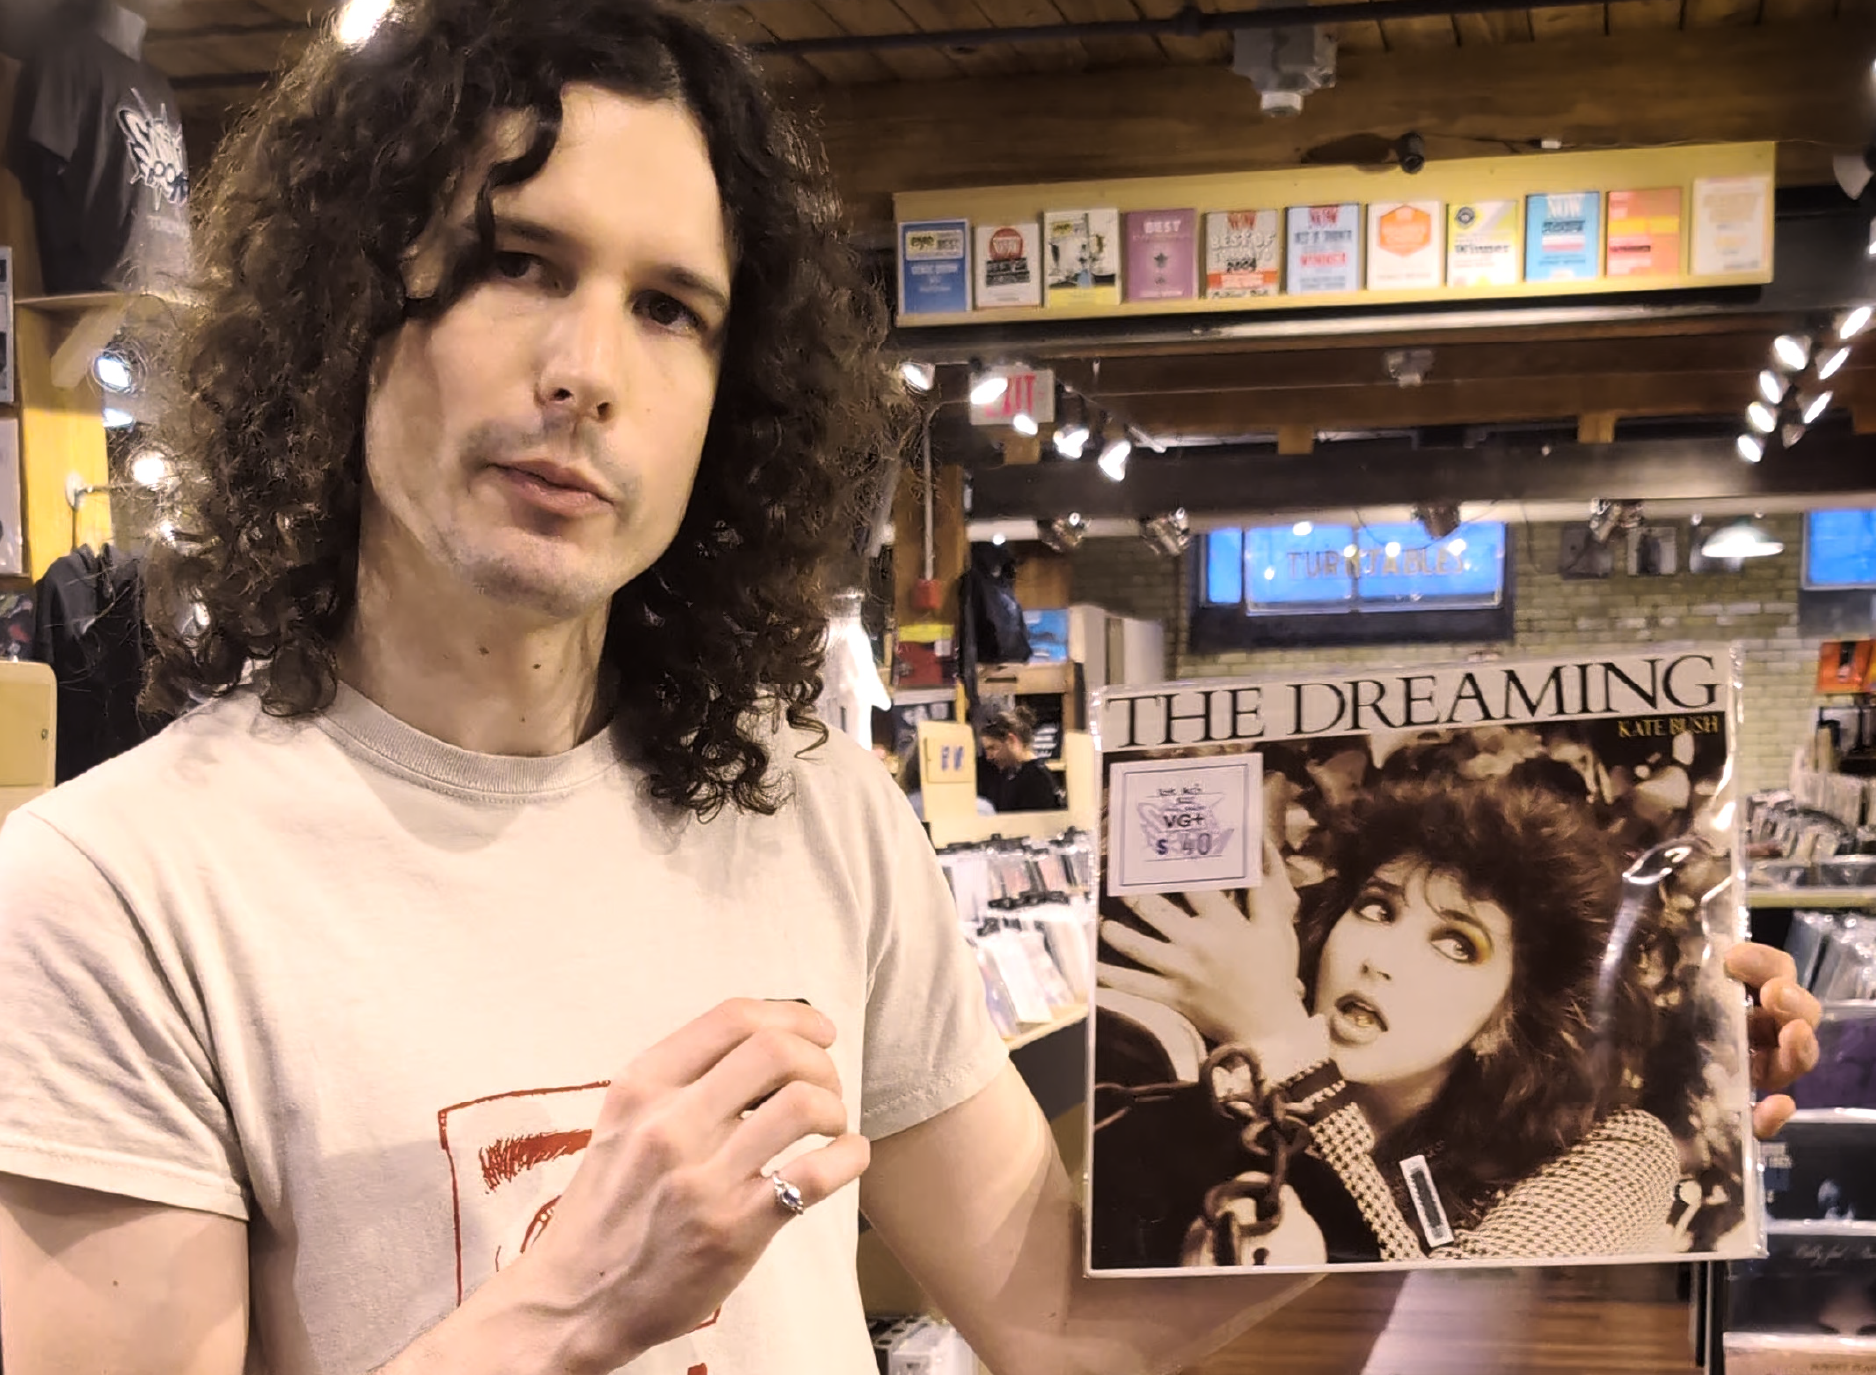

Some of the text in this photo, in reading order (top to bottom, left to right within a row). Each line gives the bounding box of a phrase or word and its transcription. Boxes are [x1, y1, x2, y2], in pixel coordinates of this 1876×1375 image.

[1143, 220, 1182, 234] BEST
[1106, 654, 1724, 748] THE DREAMING
[1618, 715, 1719, 738] KATE BUSH
[1162, 813, 1204, 828] VG+
